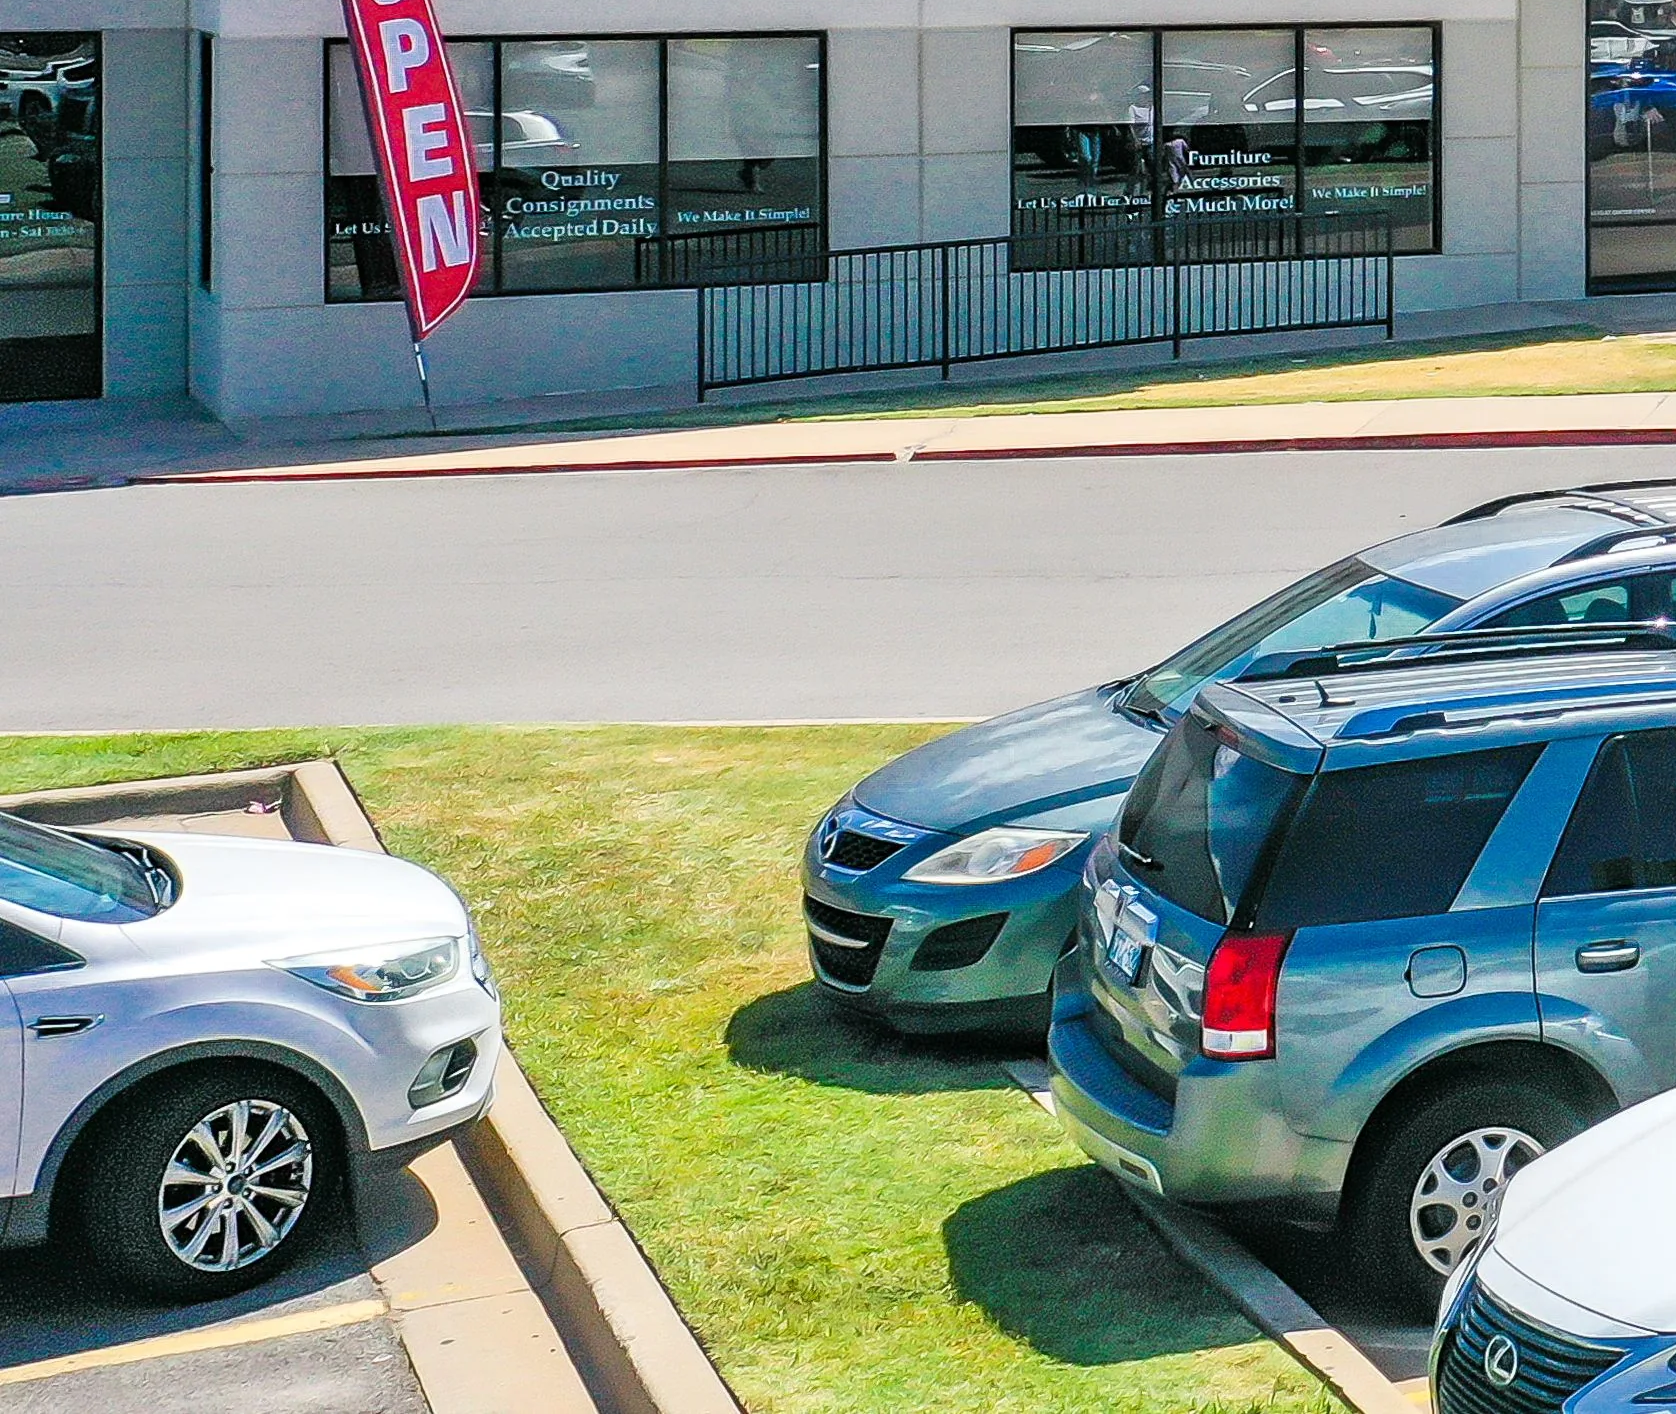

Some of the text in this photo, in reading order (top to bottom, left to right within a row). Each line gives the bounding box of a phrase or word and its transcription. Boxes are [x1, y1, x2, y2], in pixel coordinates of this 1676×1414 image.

[1188, 149, 1272, 166] Furniture
[541, 170, 621, 190] Quality
[1179, 172, 1281, 190] Accessories
[1312, 188, 1332, 199] We
[1334, 187, 1367, 198] Make
[1382, 185, 1427, 198] Simple!
[505, 195, 655, 217] Consignments
[1018, 197, 1037, 209] Let
[1040, 197, 1057, 209] Us
[1164, 194, 1294, 214] & Much More!
[677, 211, 700, 223] We
[703, 210, 742, 222] Make
[745, 209, 755, 221] It
[335, 222, 357, 235] Let
[362, 222, 381, 234] Us
[503, 218, 658, 241] Accepted Daily
